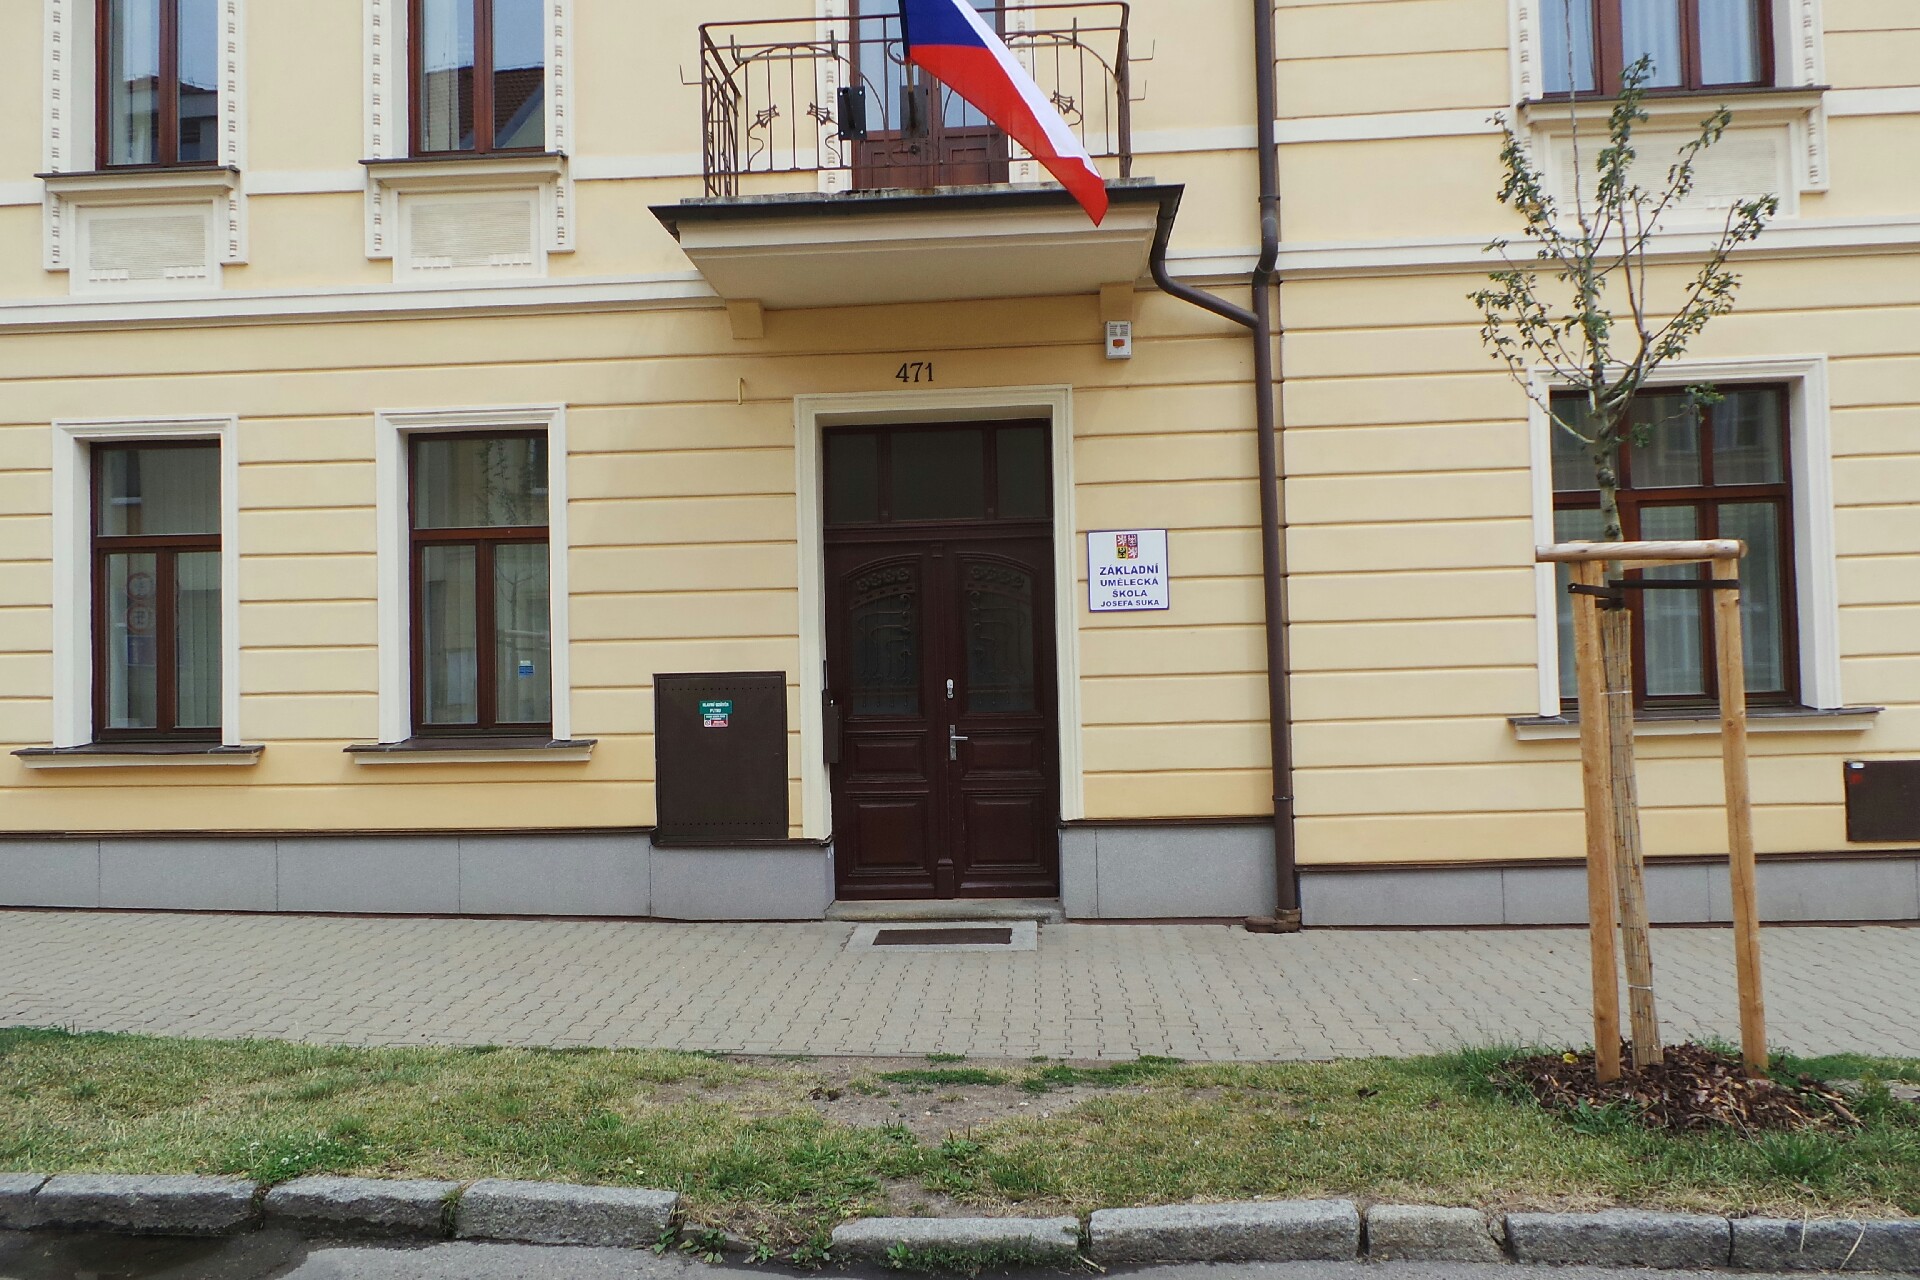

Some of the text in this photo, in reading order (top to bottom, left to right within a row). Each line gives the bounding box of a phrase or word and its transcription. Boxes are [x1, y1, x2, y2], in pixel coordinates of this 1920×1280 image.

[895, 362, 934, 383] 471
[1099, 563, 1159, 576] ZÁKLADNÍ
[1100, 577, 1159, 587] UMĚLECKÁ
[1112, 589, 1148, 598] ŠKOLA
